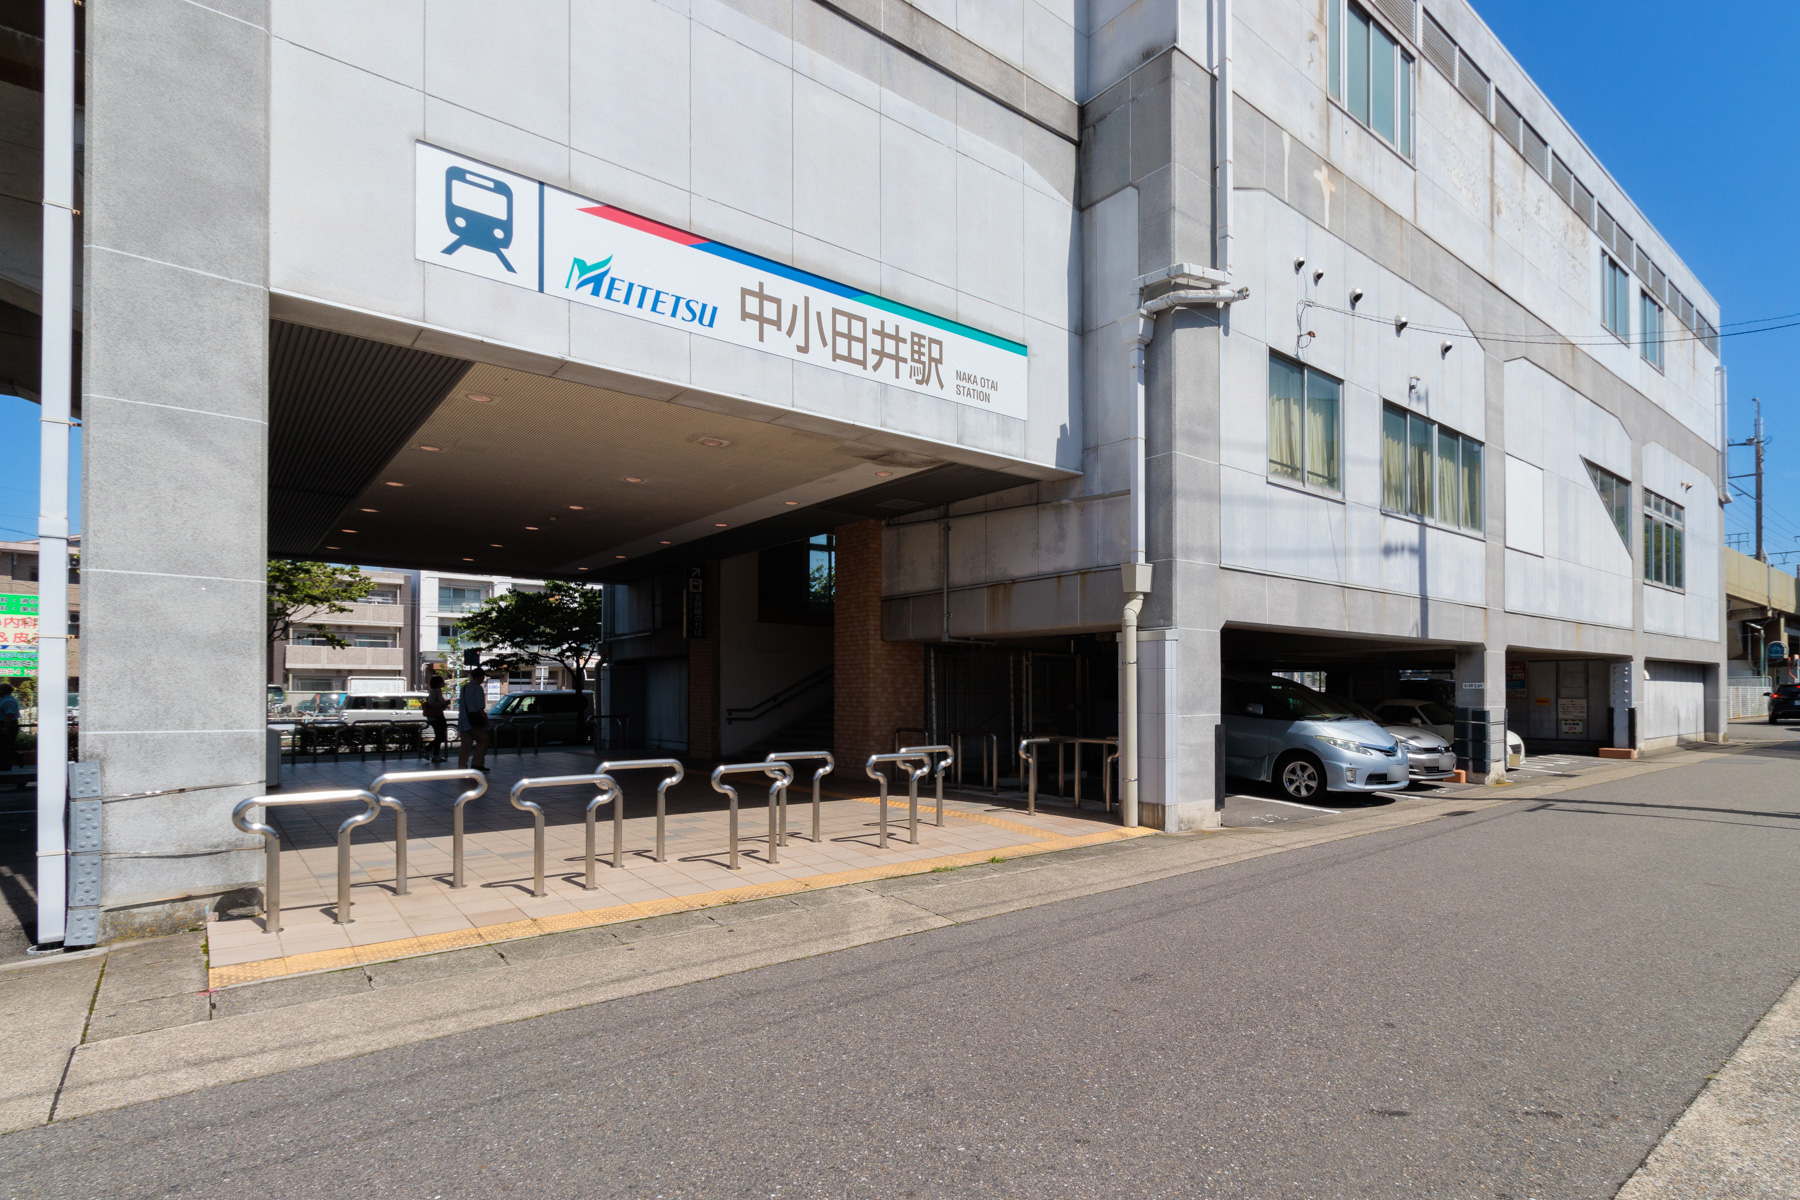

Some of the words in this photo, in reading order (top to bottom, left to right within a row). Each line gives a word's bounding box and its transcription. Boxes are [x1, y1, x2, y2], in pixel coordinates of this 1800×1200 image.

[565, 253, 718, 329] MEITETSU
[740, 281, 945, 391] 中小田井駅
[956, 370, 978, 386] NAKA
[980, 377, 998, 391] OTAI
[956, 384, 990, 403] STATION
